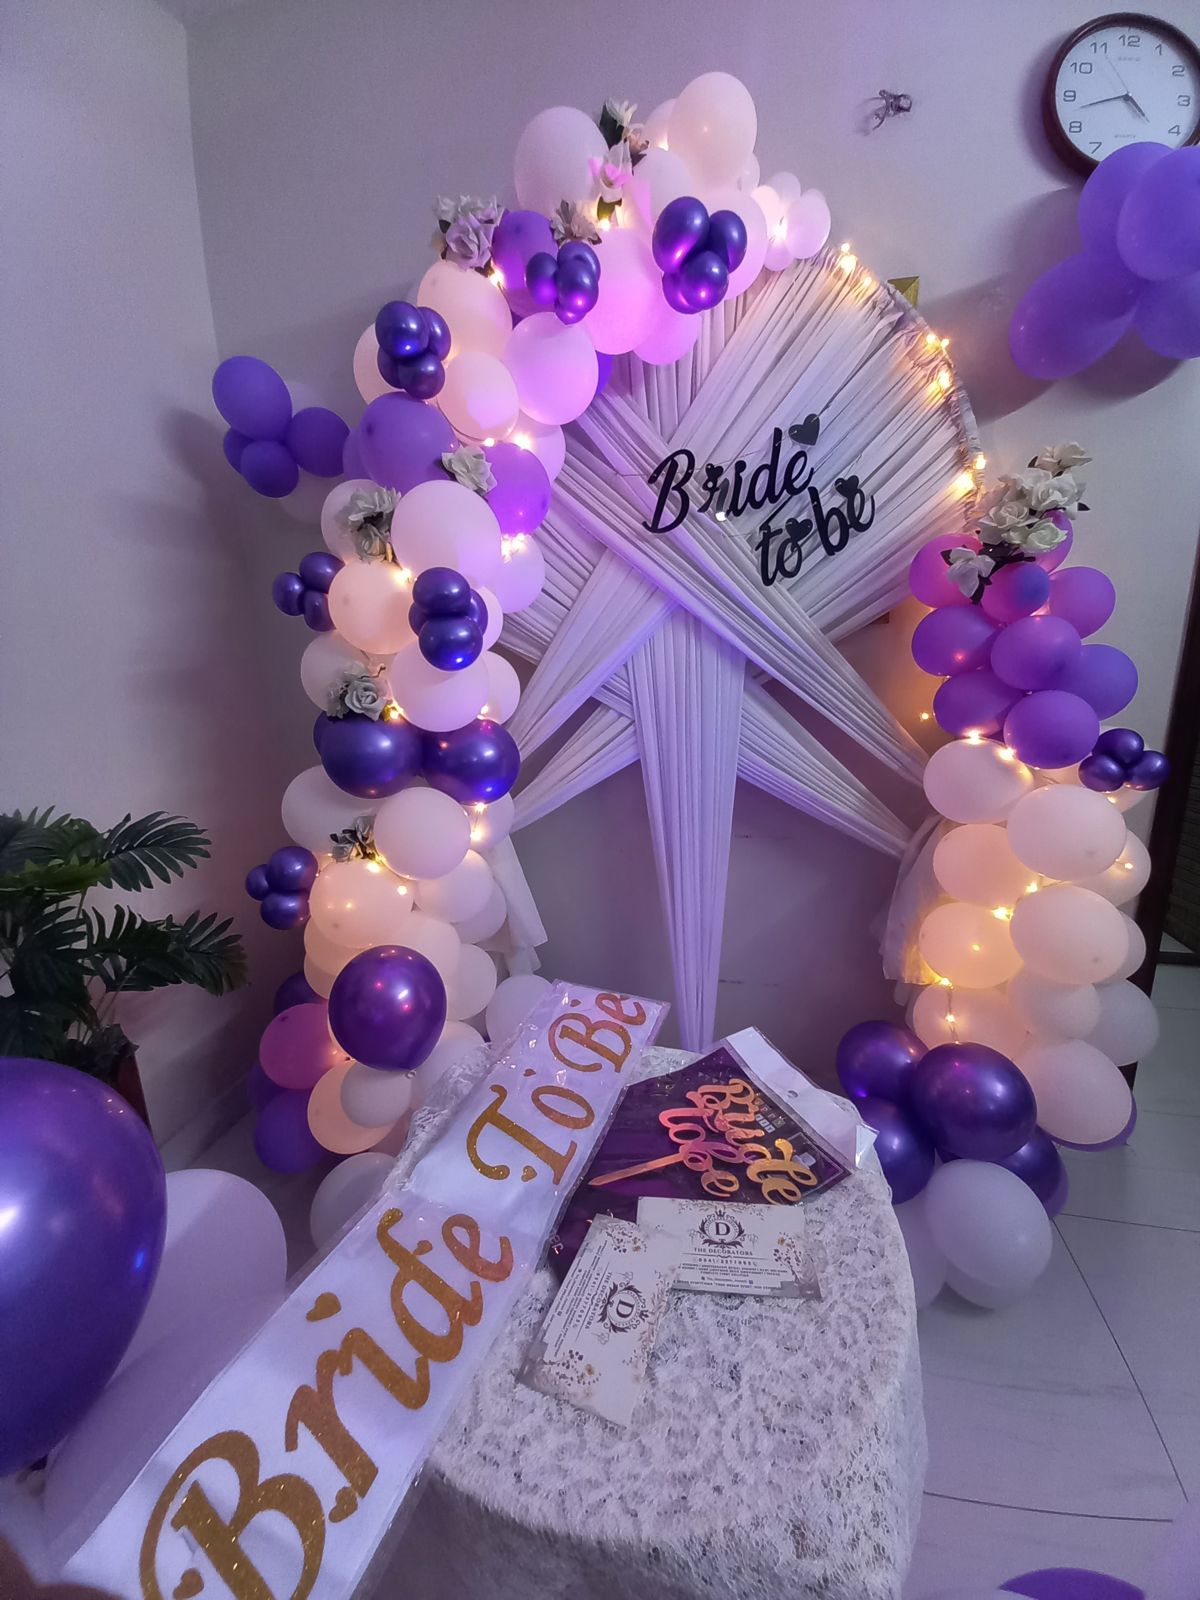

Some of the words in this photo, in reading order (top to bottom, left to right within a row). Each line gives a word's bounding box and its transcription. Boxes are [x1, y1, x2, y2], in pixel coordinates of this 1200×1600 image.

[1118, 34, 1141, 48] 12
[1089, 42, 1108, 54] 11
[1154, 44, 1163, 56] 1
[1070, 62, 1093, 75] 10
[1171, 65, 1186, 77] 2
[1063, 90, 1077, 102] 9
[1177, 95, 1191, 107] 3
[1068, 121, 1082, 133] 8
[1168, 124, 1181, 136] 4
[1089, 142, 1102, 154] 7
[642, 427, 814, 534] Bride
[755, 521, 803, 587] to
[808, 484, 875, 557] be
[697, 1078, 818, 1205] Bride
[714, 1221, 731, 1236] D
[708, 1248, 753, 1257] DECORATORS
[139, 1207, 513, 1600] Bride
[466, 1084, 595, 1185] To
[548, 992, 647, 1073] Be
[584, 1284, 606, 1329] DECORATORS
[616, 1300, 634, 1319] D
